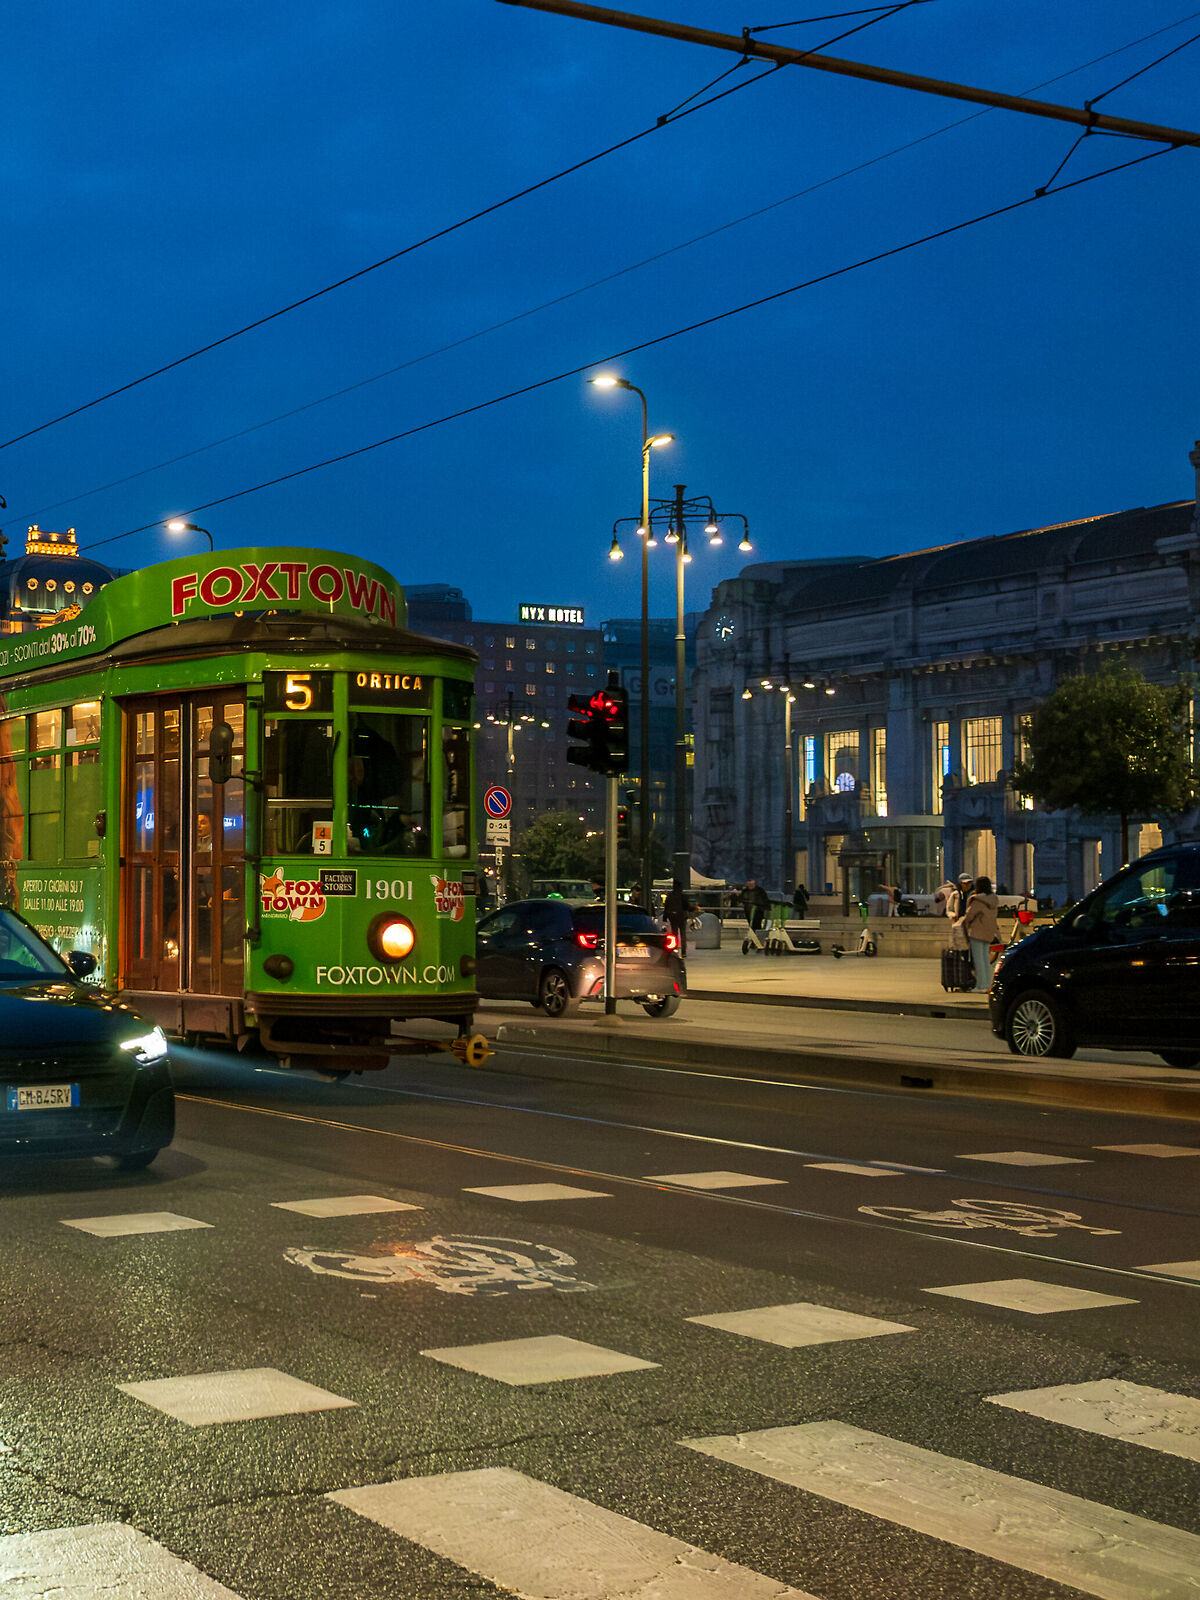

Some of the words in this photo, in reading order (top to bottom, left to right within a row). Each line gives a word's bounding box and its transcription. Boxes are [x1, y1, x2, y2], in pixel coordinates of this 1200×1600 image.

[172, 563, 397, 628] FOXTOWN
[521, 607, 545, 620] NYX
[548, 608, 584, 623] HOTEL
[14, 641, 39, 662] SCONTI
[39, 637, 51, 656] dal
[51, 632, 69, 654] 30%
[70, 631, 78, 647] al
[78, 625, 97, 647] 70%
[285, 674, 313, 711] 5
[356, 672, 423, 691] ORTICA
[318, 840, 326, 852] 5
[23, 880, 43, 892] APERTO
[49, 880, 69, 893] GIORNI
[70, 880, 79, 893] SU
[323, 883, 353, 891] STORES
[324, 874, 353, 884] FACTORY
[284, 880, 324, 896] FOX
[366, 879, 413, 900] 1901
[24, 898, 40, 910] DALLE
[55, 899, 68, 911] ALLE
[69, 899, 84, 912] 19.00
[261, 896, 324, 911] TOWN
[316, 965, 456, 985] FOXTOWN.COM
